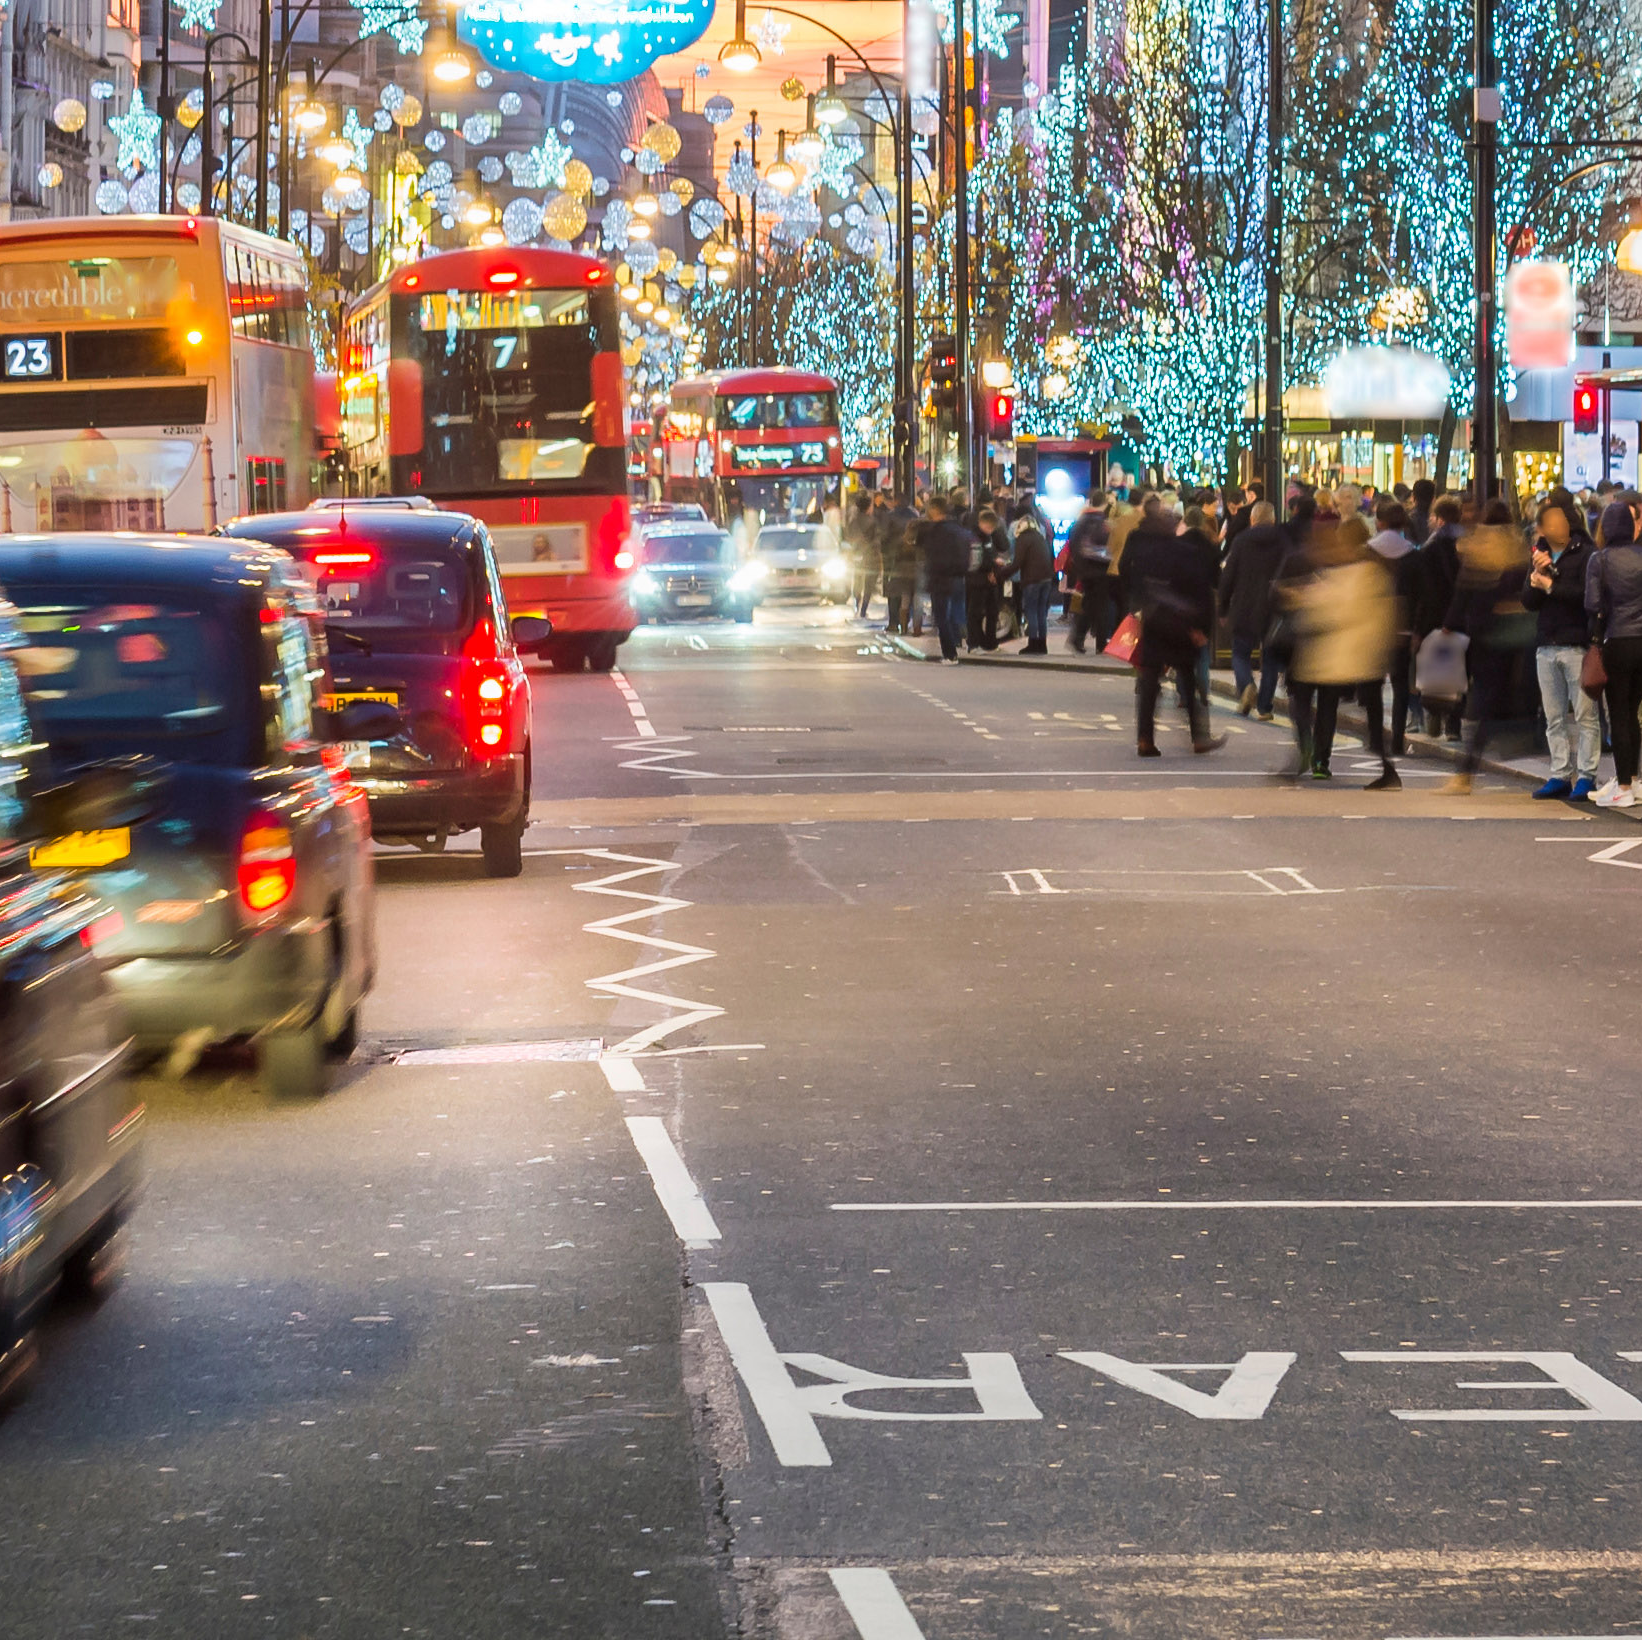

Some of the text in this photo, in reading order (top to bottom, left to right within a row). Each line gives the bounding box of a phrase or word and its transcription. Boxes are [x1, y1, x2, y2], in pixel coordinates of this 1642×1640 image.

[6, 339, 49, 376] 23
[492, 336, 518, 369] 7
[800, 442, 824, 463] 73
